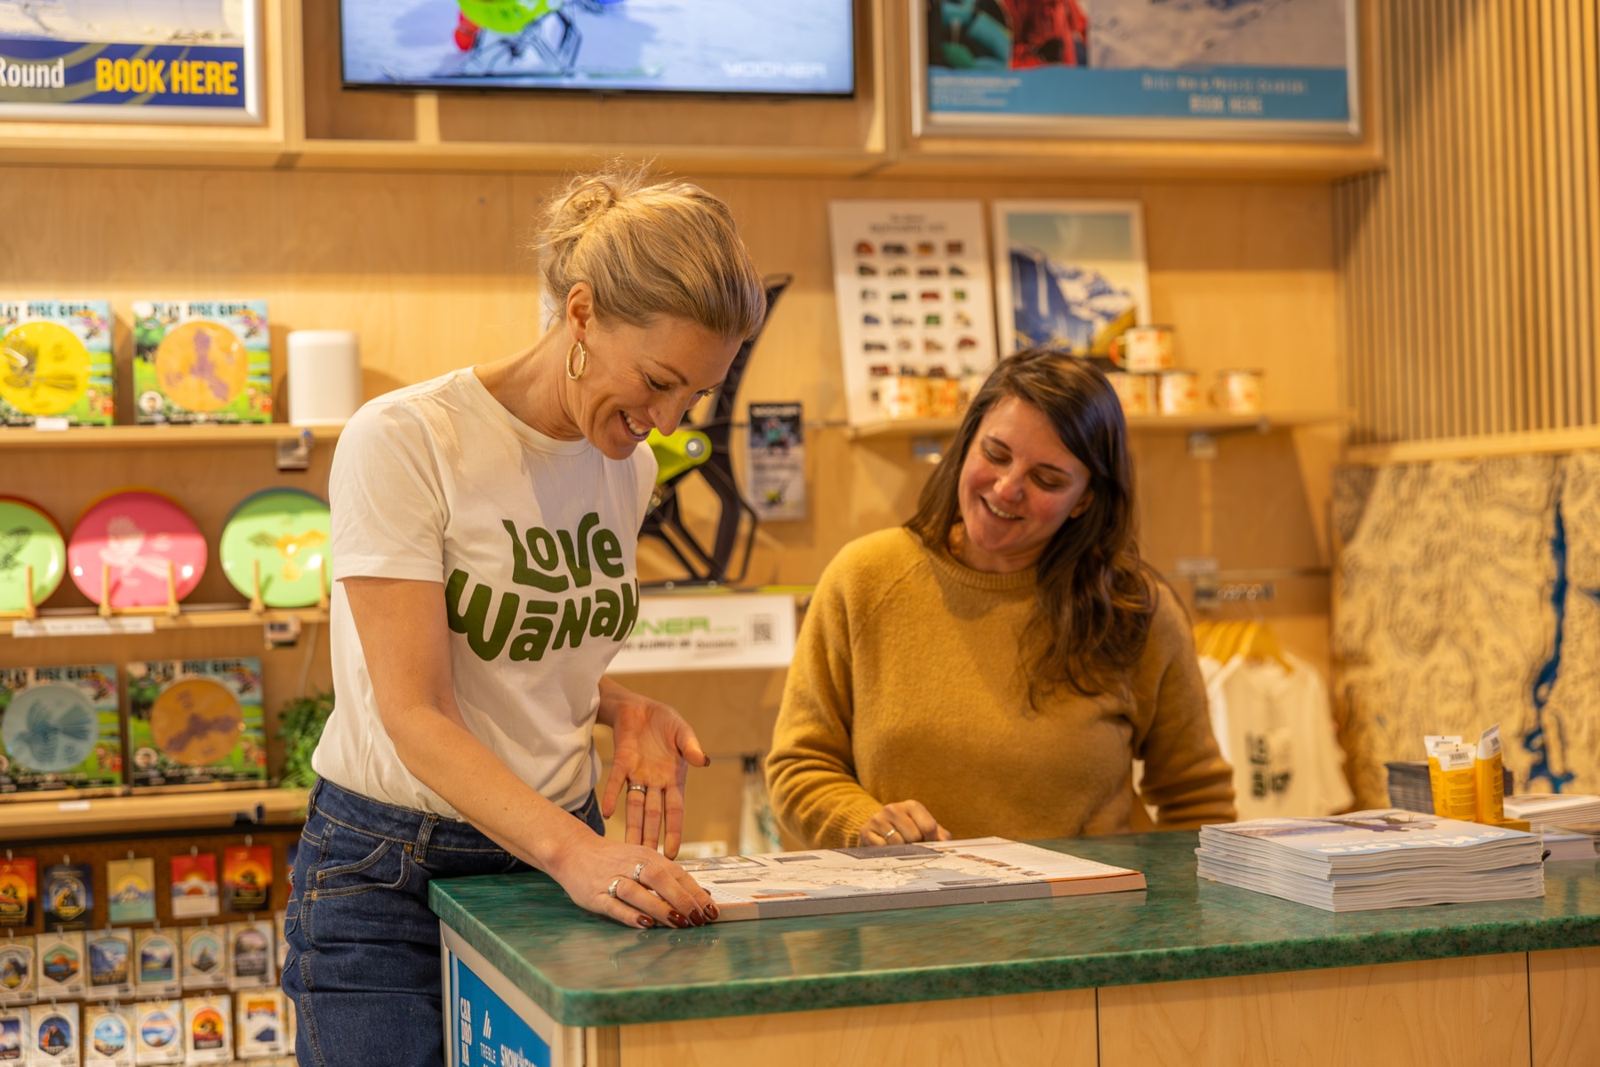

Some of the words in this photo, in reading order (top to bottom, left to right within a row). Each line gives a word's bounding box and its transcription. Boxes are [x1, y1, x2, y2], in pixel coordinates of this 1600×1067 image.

[0, 57, 65, 88] Round
[95, 58, 165, 93] BOOK
[170, 59, 238, 95] HERE
[502, 512, 625, 593] Love
